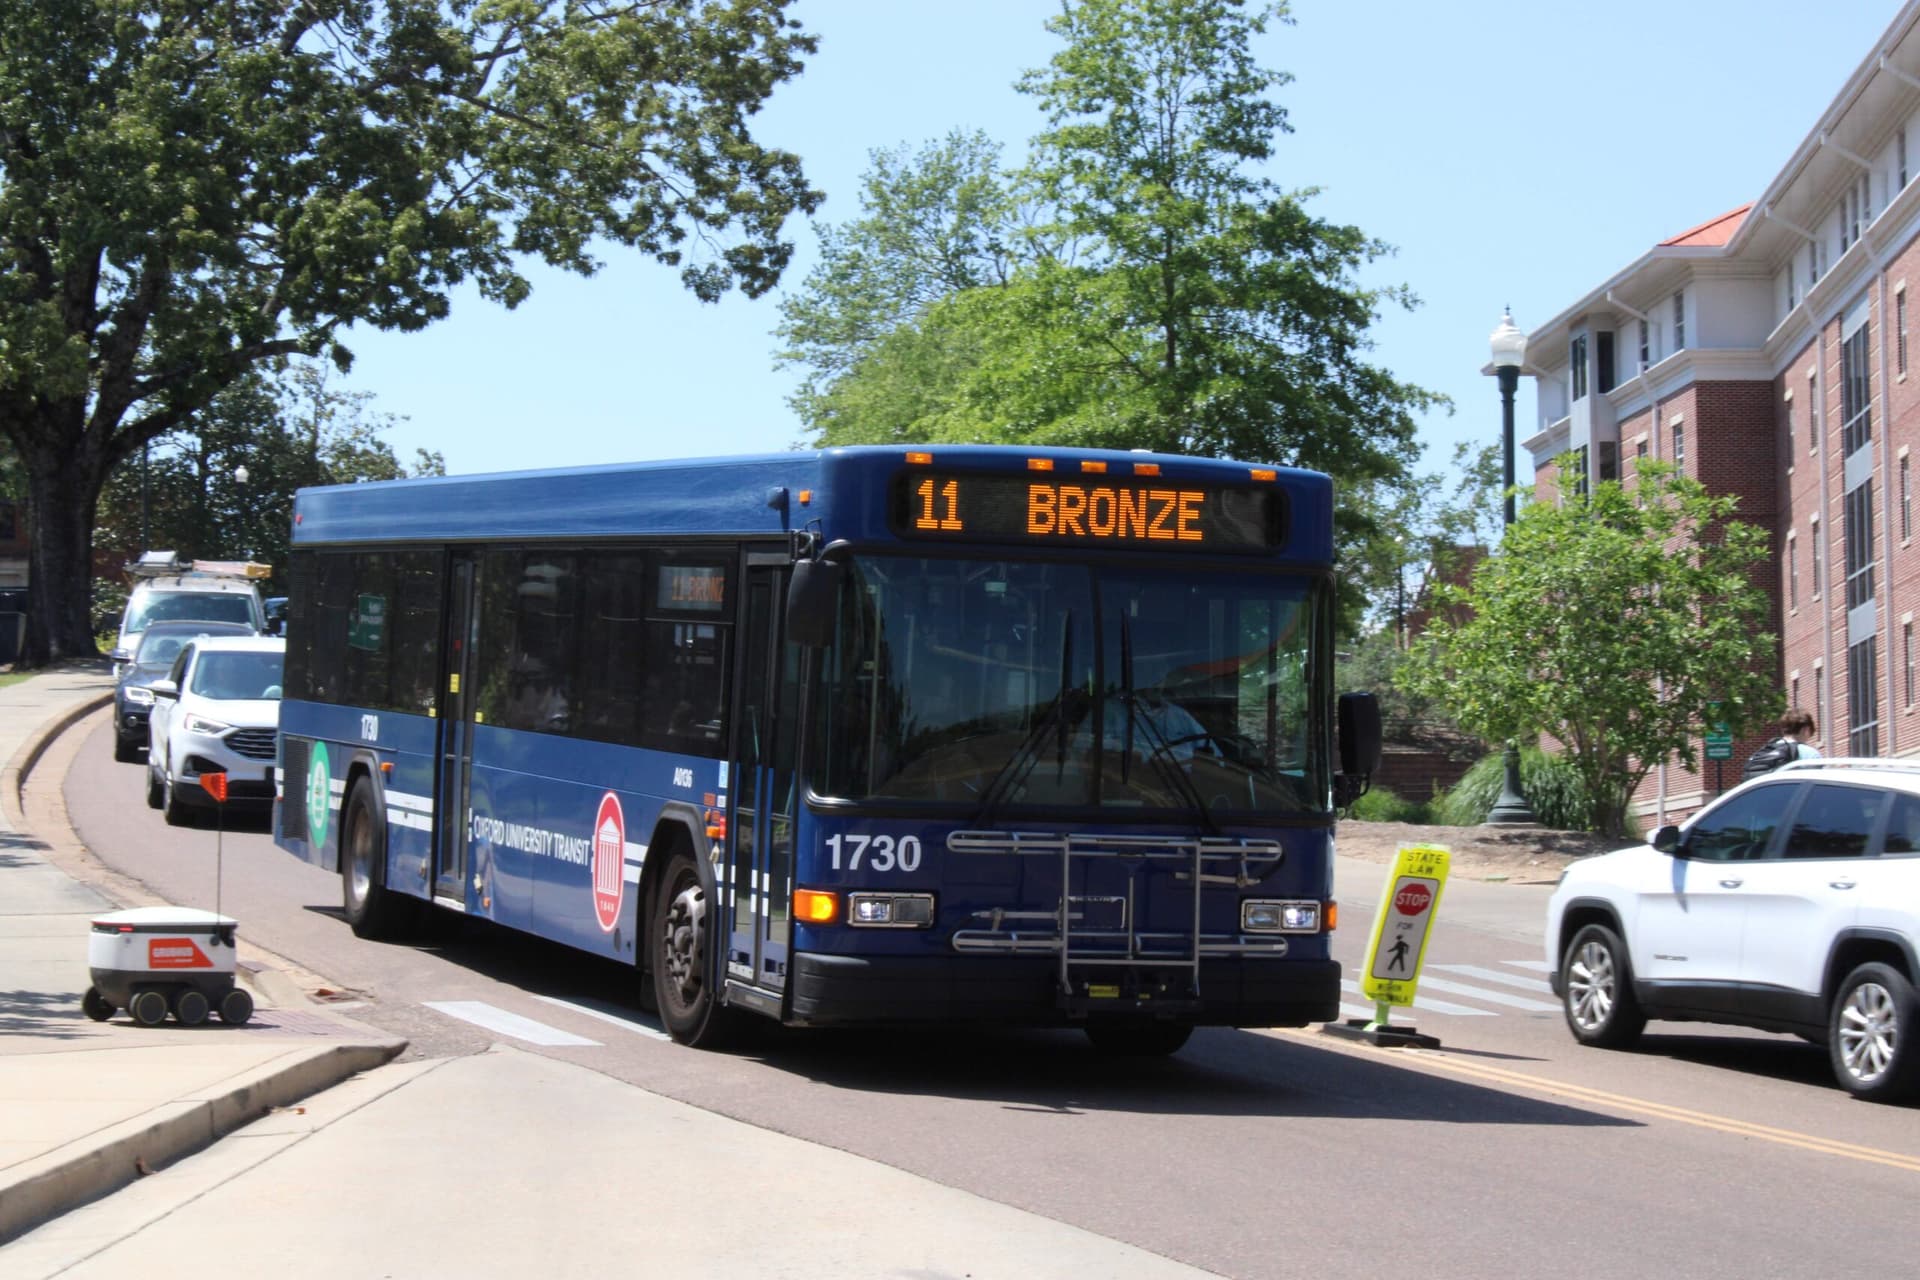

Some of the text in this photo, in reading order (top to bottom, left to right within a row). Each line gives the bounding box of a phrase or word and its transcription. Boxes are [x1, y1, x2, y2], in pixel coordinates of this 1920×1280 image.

[917, 480, 1205, 541] 11 BRONZE
[361, 713, 379, 741] 1730
[474, 816, 590, 866] OXFORD UNIVERSITY TRANSIT
[825, 834, 921, 872] 1730
[1407, 852, 1443, 865] STATE
[1408, 864, 1434, 875] LAW
[1396, 892, 1428, 906] STOP
